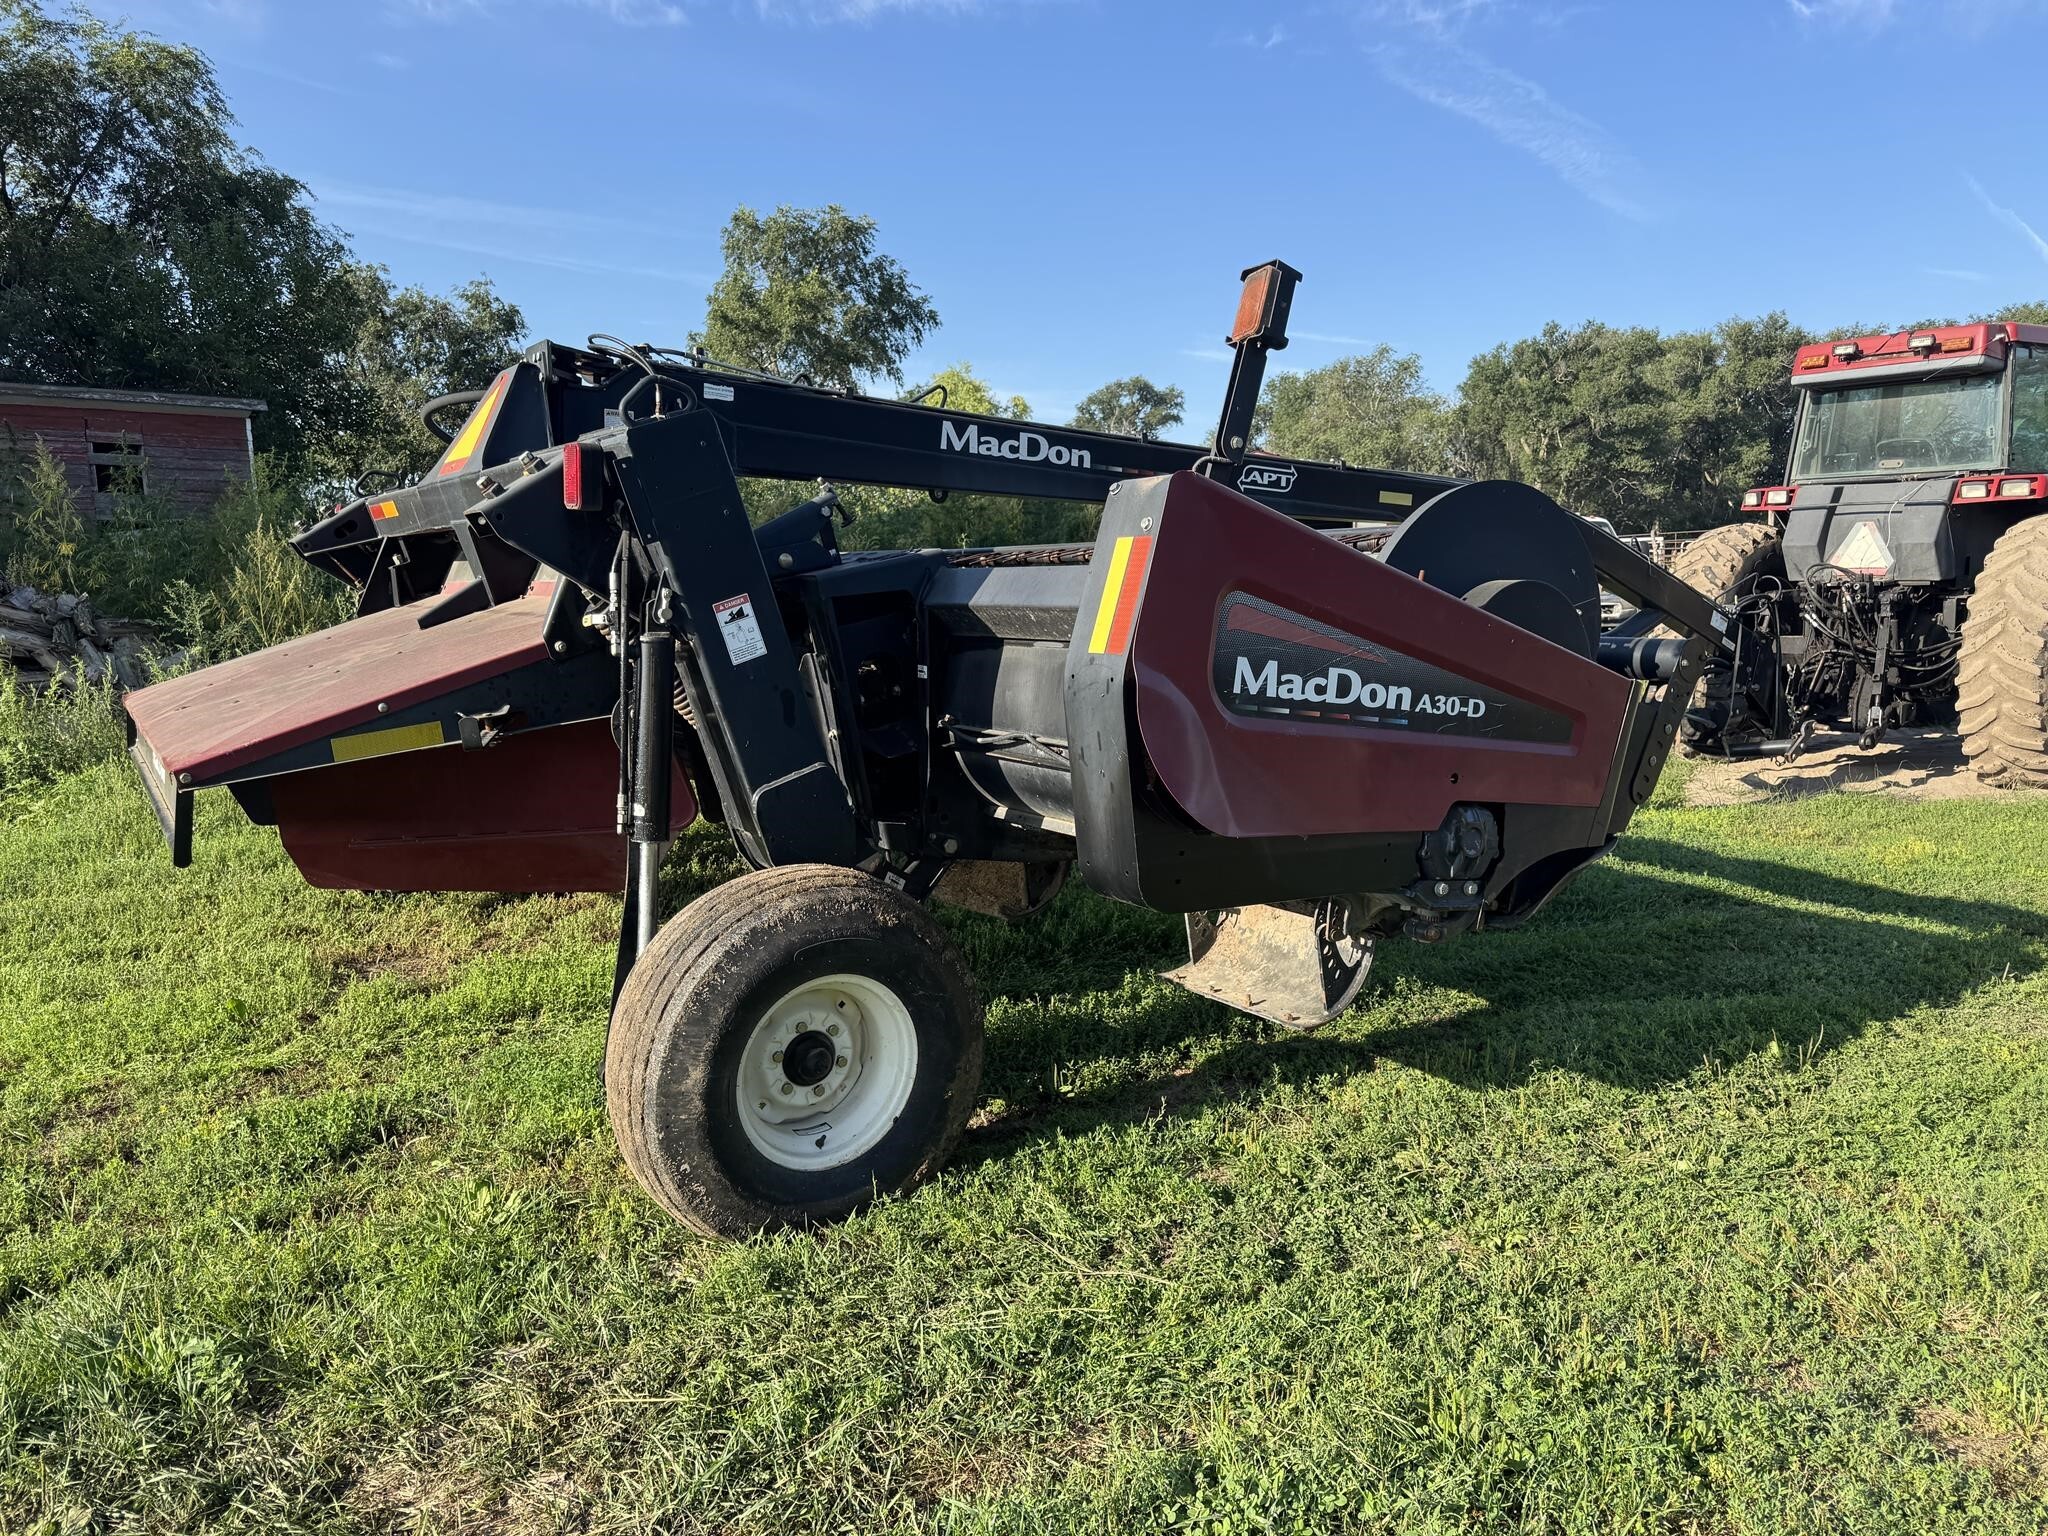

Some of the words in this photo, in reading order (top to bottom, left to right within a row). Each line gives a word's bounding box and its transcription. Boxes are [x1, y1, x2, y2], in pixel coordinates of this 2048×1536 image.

[940, 420, 1091, 469] MacDon
[1245, 470, 1293, 487] APT
[724, 597, 745, 609] DANGER
[1232, 656, 1413, 711] MacDon
[1415, 694, 1486, 718] A30-D
